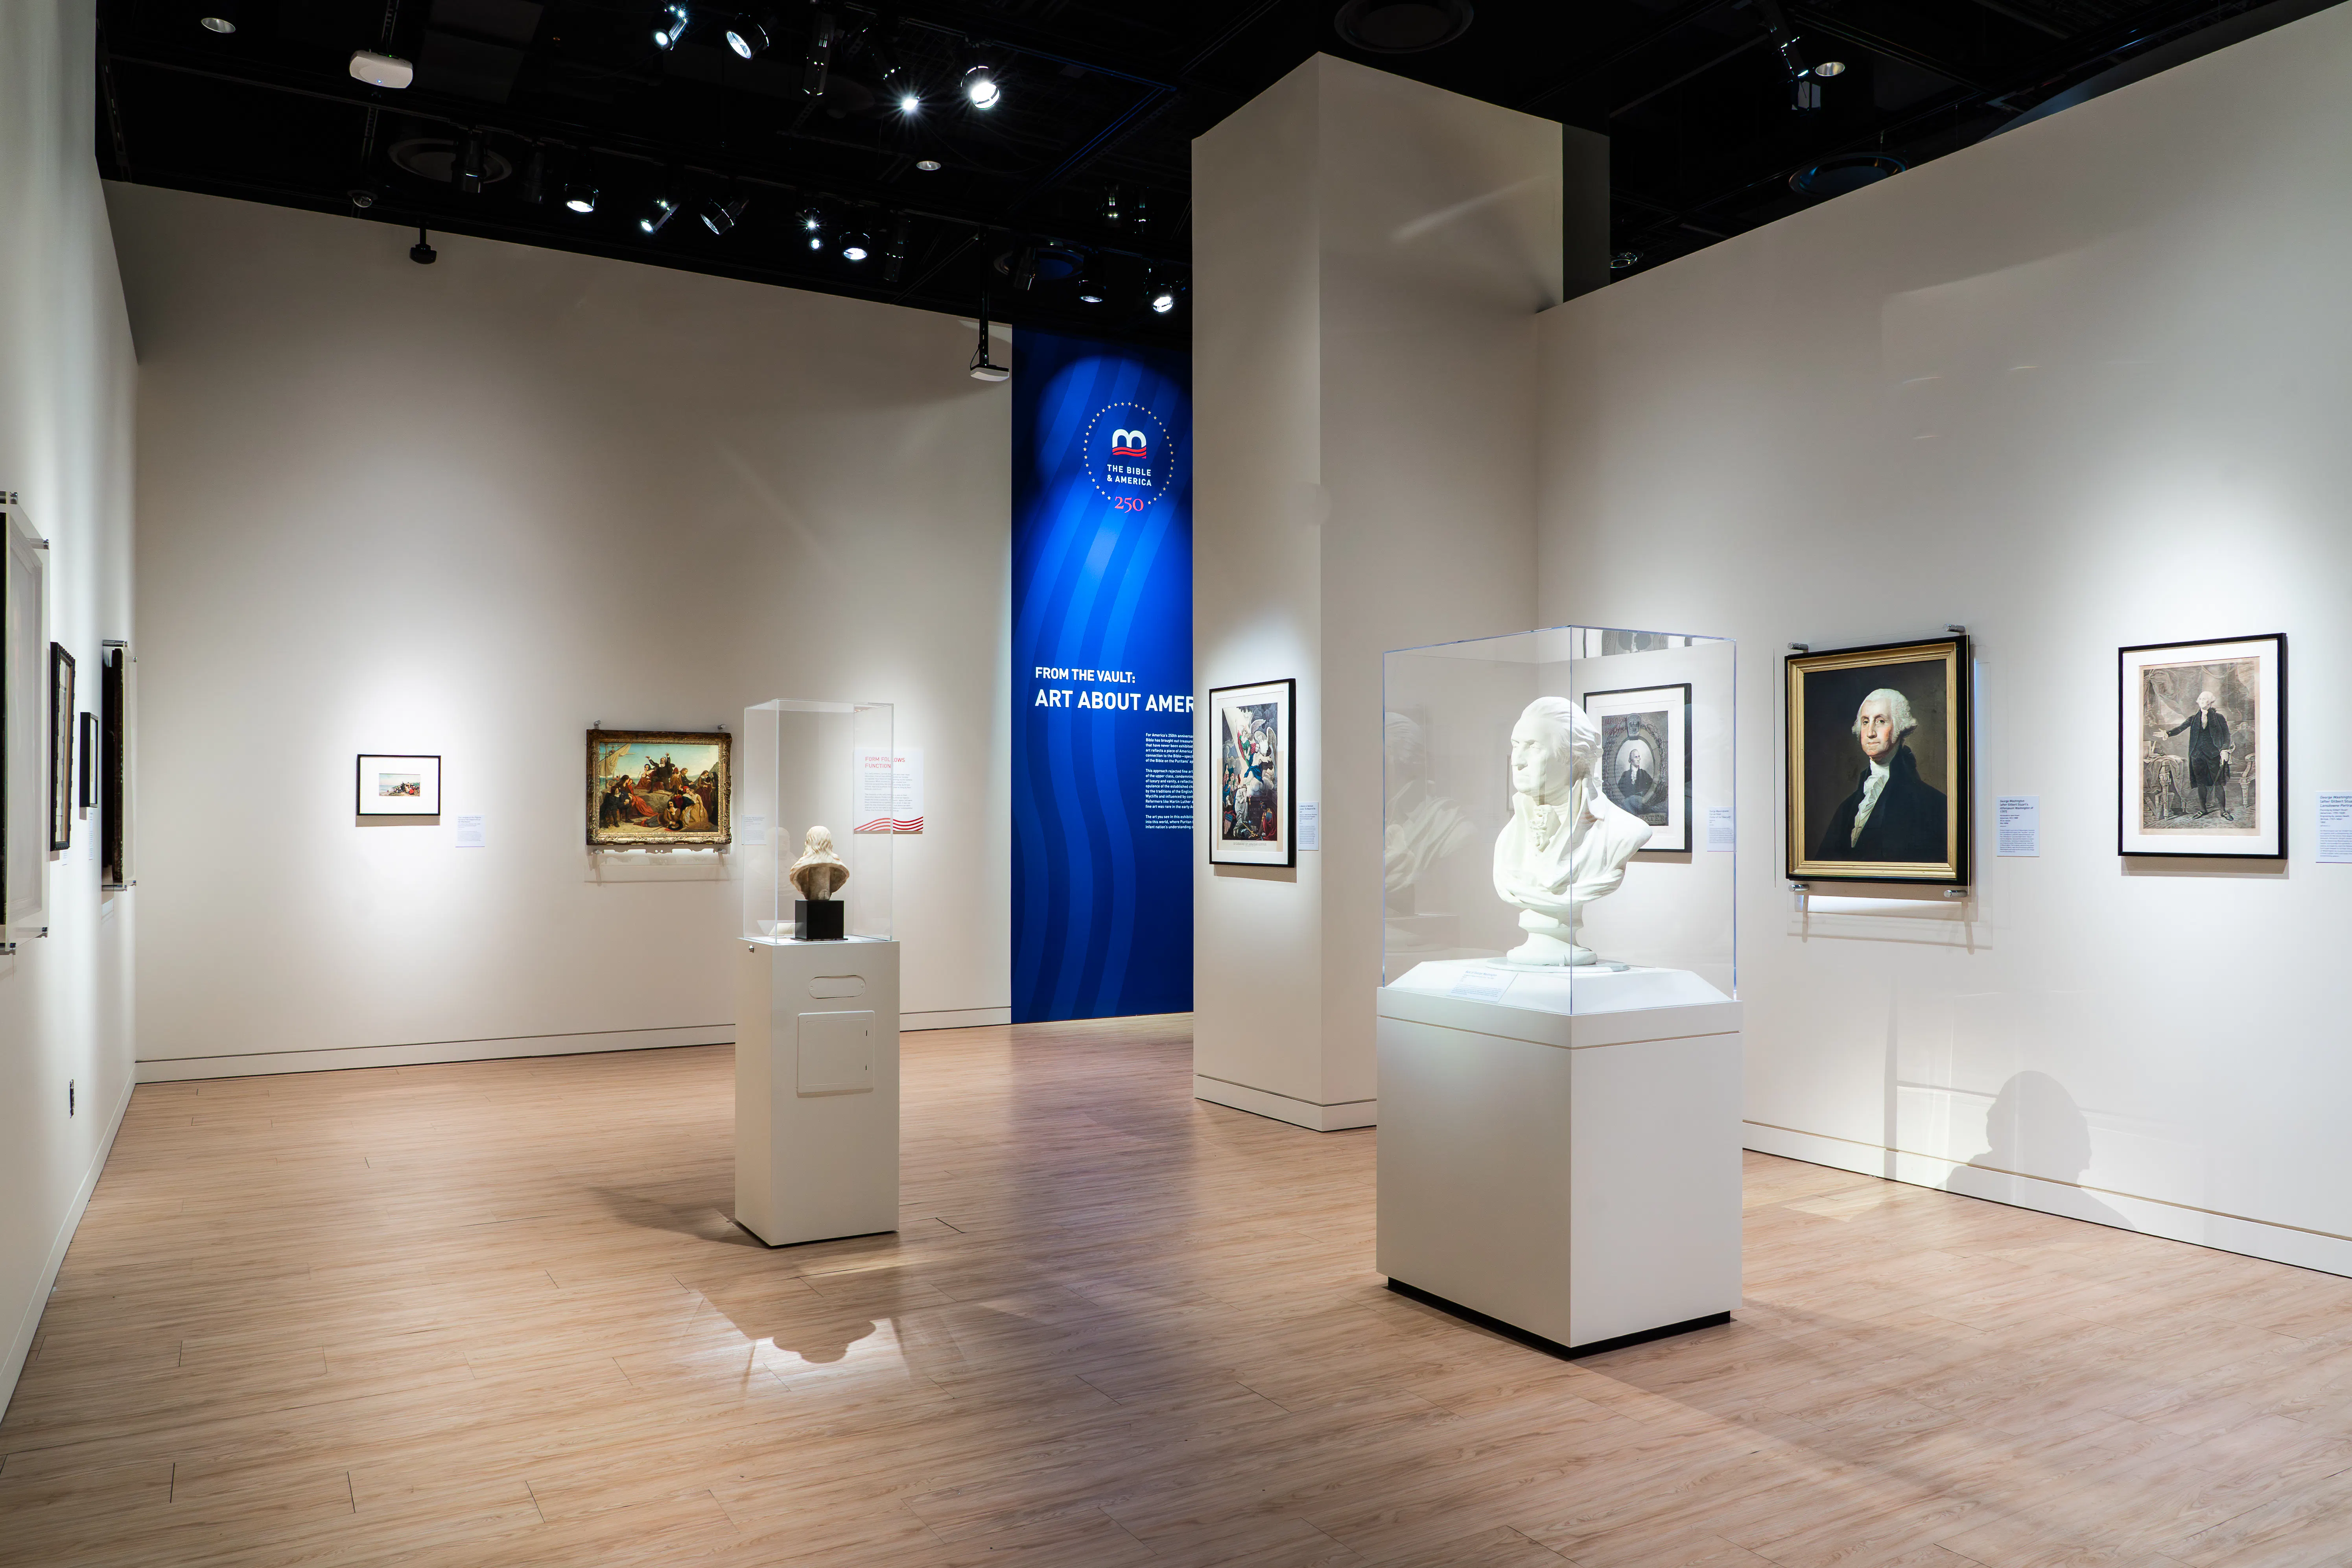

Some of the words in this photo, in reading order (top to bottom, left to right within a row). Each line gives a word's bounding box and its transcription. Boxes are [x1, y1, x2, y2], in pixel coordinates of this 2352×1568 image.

[1107, 464, 1123, 473] THE
[1127, 466, 1151, 476] BIBLE
[1115, 476, 1152, 486] AMERICA
[1114, 496, 1143, 513] 250
[1036, 667, 1069, 680] FROM
[1071, 669, 1095, 681] THE
[1097, 670, 1135, 683] VAULT:
[1035, 689, 1073, 708] ART
[1077, 691, 1141, 711] ABOUT
